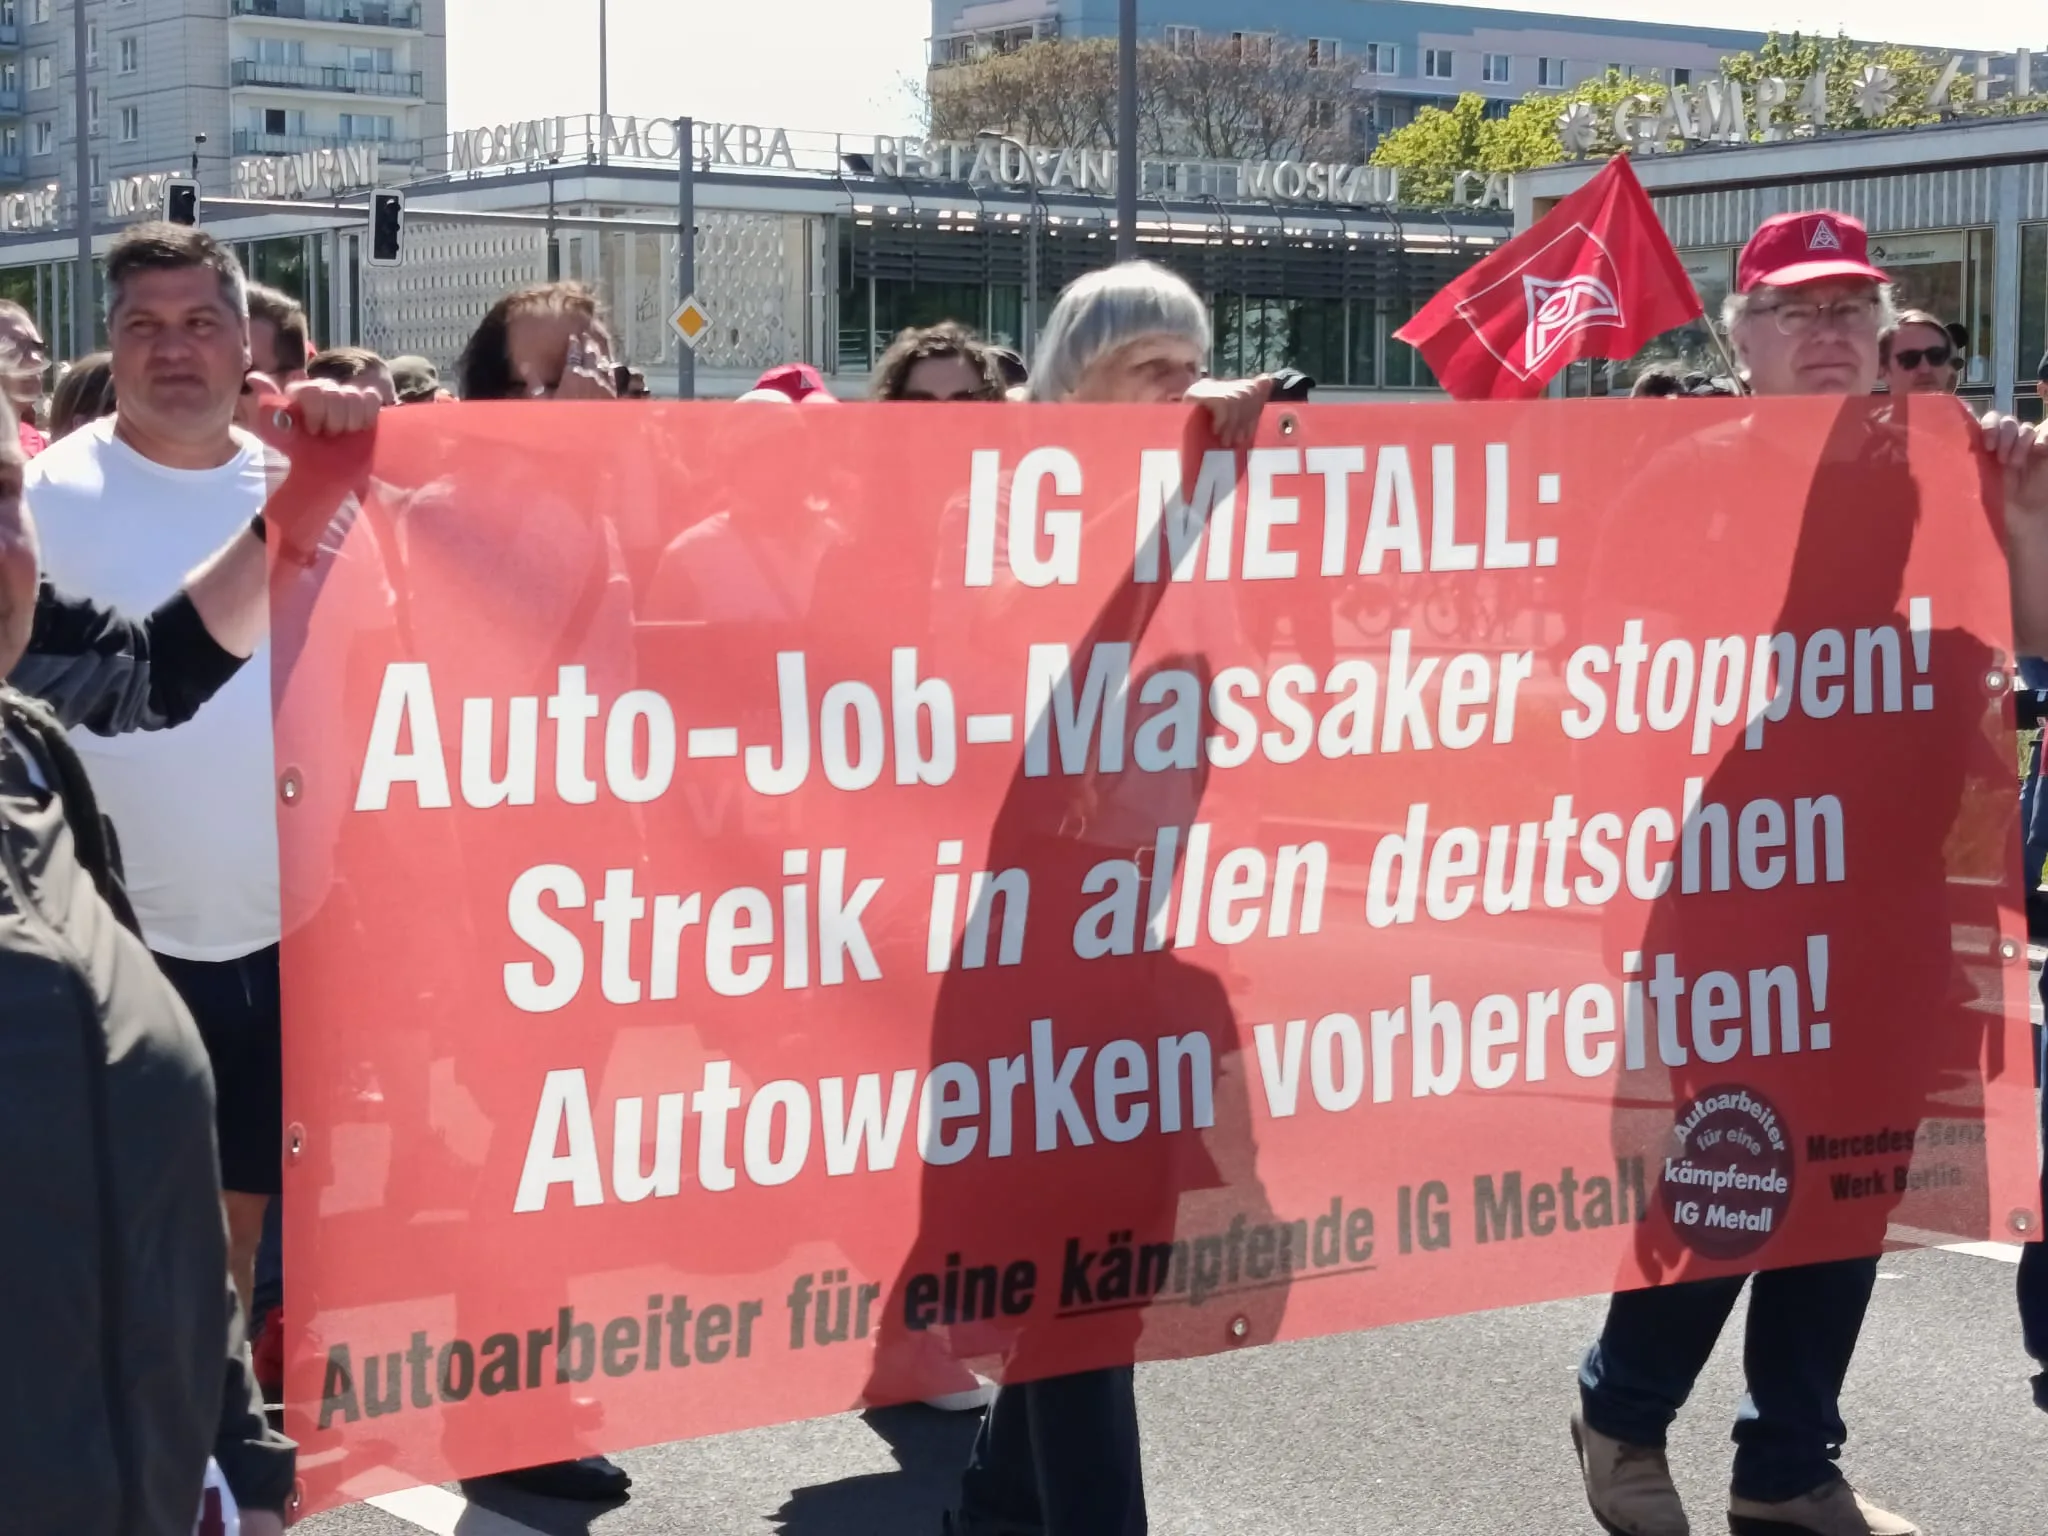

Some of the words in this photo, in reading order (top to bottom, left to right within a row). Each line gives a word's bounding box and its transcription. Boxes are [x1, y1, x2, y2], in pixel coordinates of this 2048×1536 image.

[235, 143, 379, 199] RESTAURANT
[452, 116, 565, 171] MOSKAU
[1237, 158, 1400, 204] MOSKAU
[964, 447, 1083, 588] IG
[1133, 443, 1560, 583] METALL:
[353, 629, 1532, 812] Auto-Job-Massaker
[1560, 596, 1936, 757] stoppen!
[503, 847, 884, 1013] Streik
[926, 840, 1031, 973] in
[1072, 822, 1329, 960] allen
[1365, 777, 1846, 927] deutschen
[512, 1018, 1215, 1214] Autowerken
[1253, 934, 1832, 1118] vorbereiten!
[1674, 1091, 1785, 1151] Autoarbeiter
[1696, 1129, 1722, 1151] für
[1726, 1128, 1761, 1156] eine
[1665, 1158, 1788, 1194] kämpfende
[1830, 1170, 1887, 1200] Werk
[1674, 1200, 1700, 1225] IG
[1705, 1204, 1773, 1232] Metall
[317, 1294, 762, 1431] Autoarbeiter
[787, 1270, 881, 1350] für
[903, 1252, 1037, 1331] eine
[1058, 1196, 1375, 1312] kämpfende
[1398, 1179, 1451, 1255] IG
[1473, 1156, 1648, 1245] Metall
